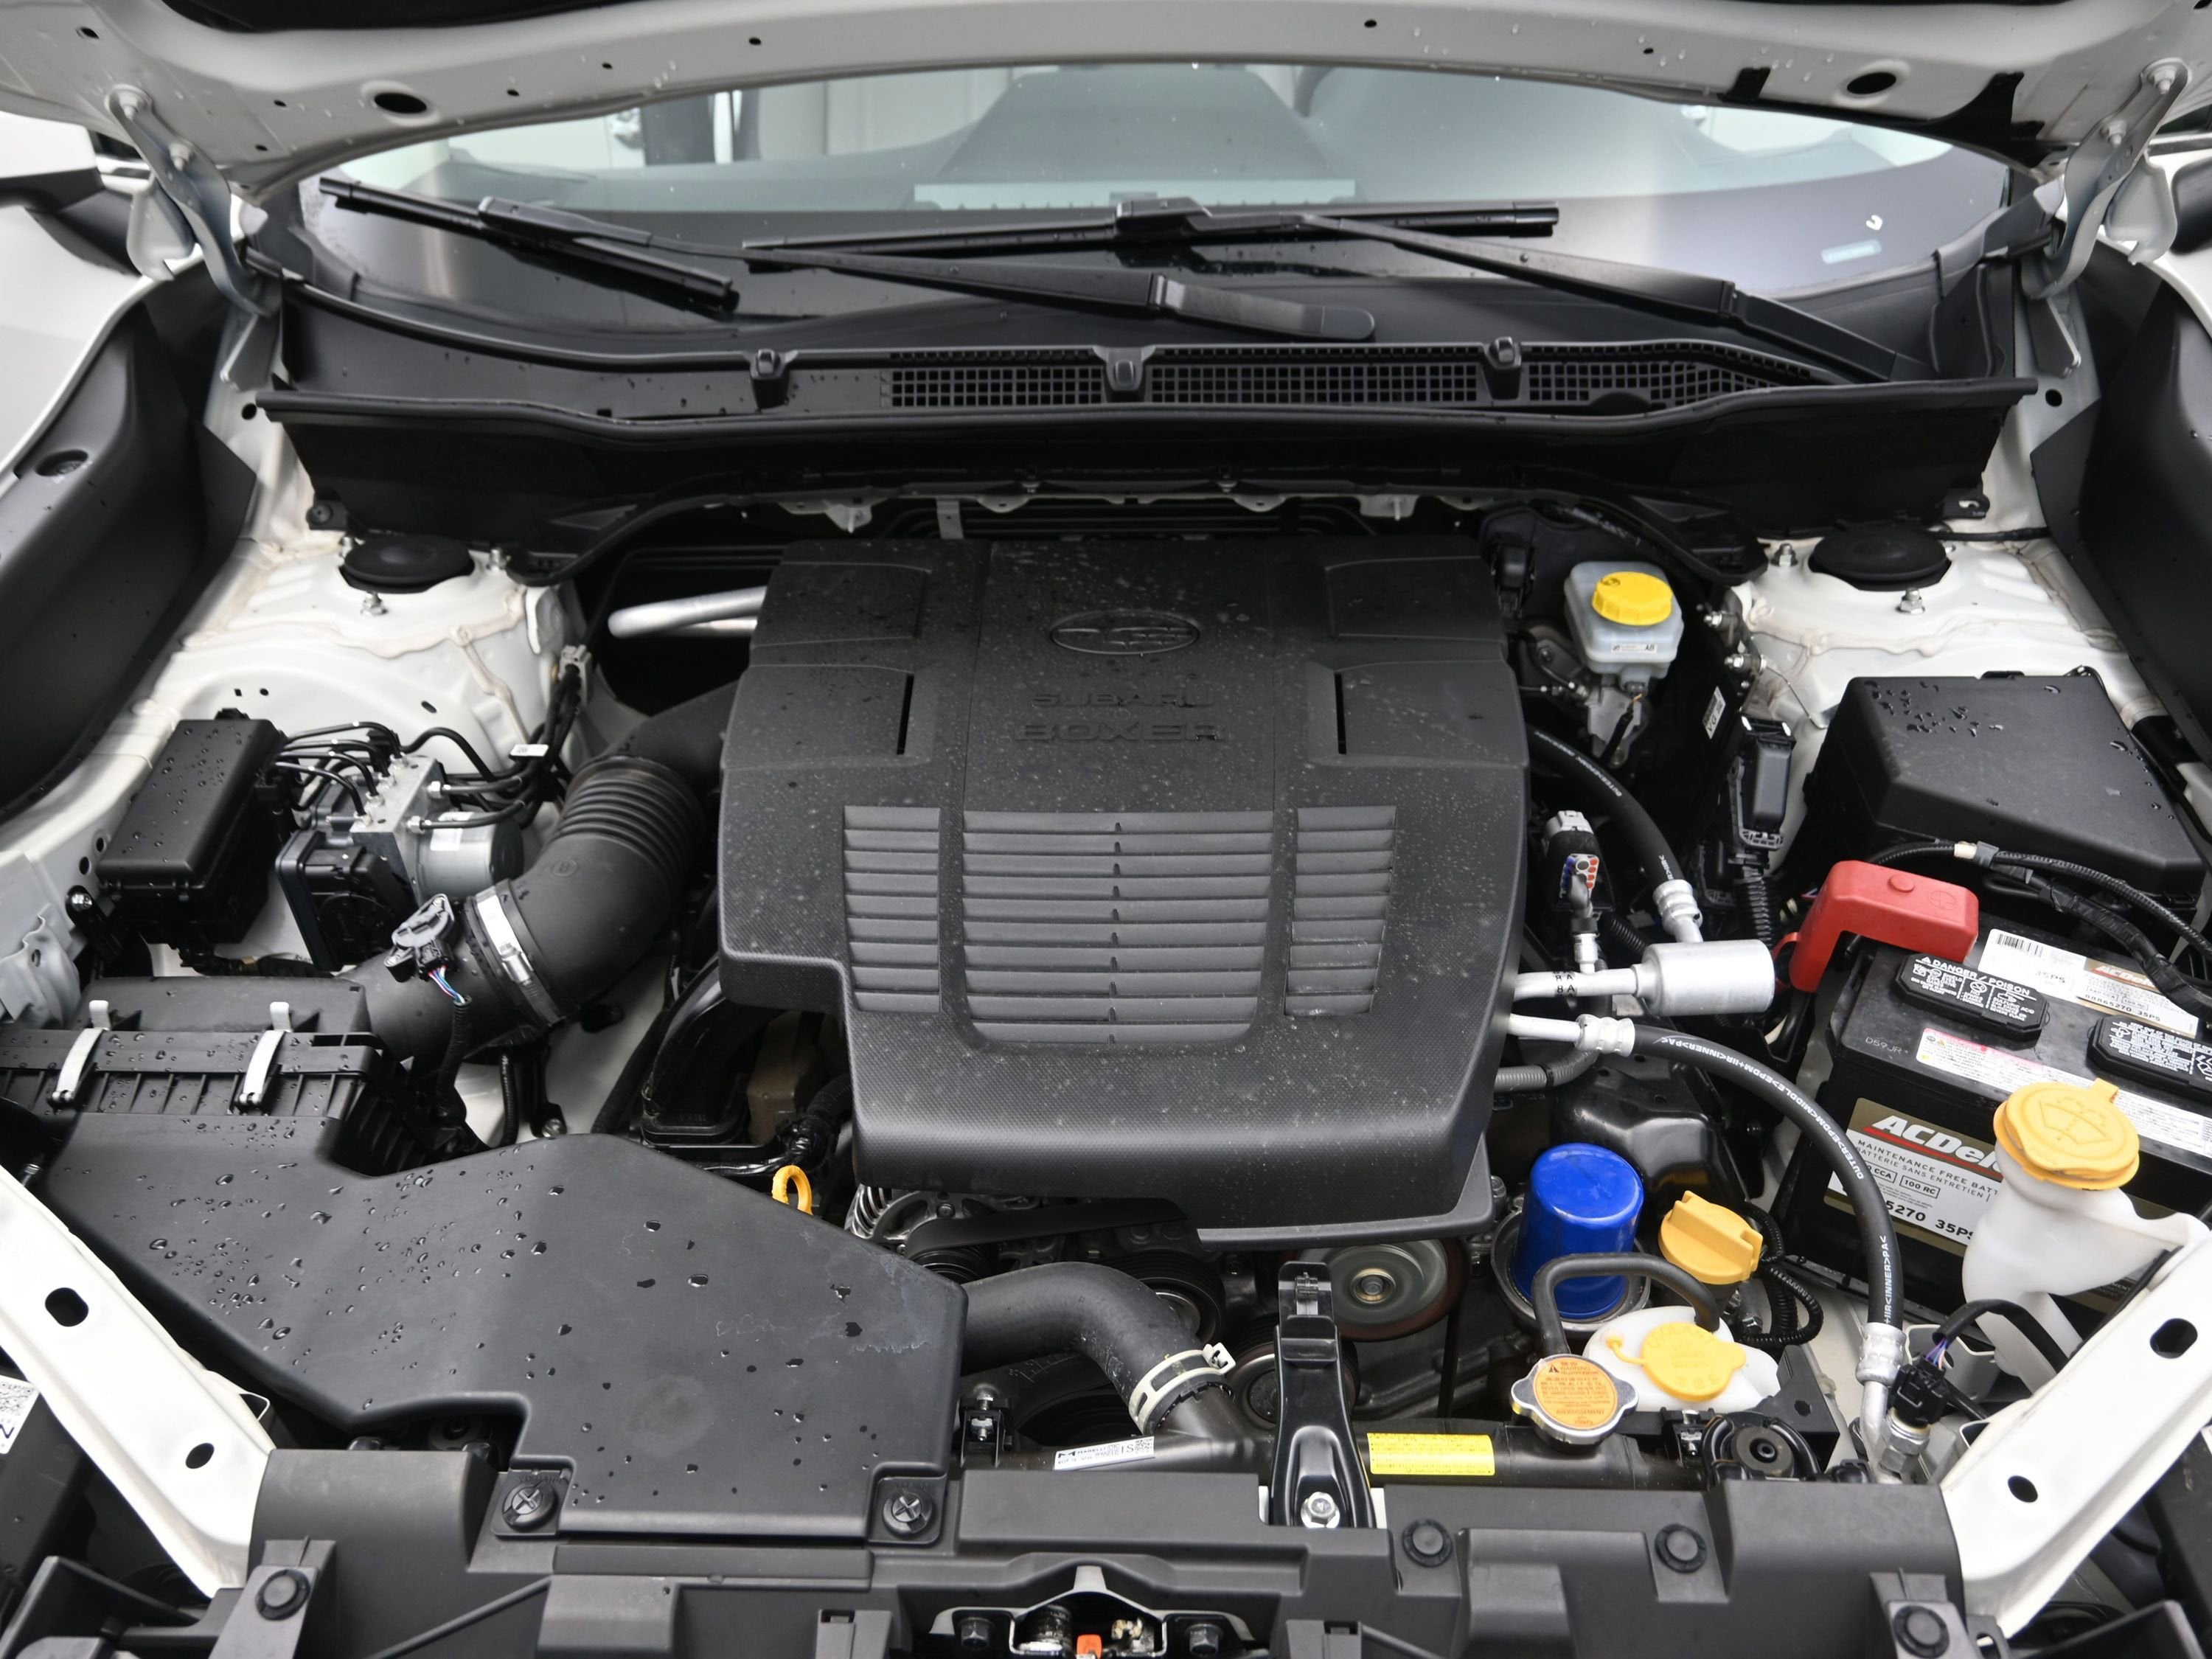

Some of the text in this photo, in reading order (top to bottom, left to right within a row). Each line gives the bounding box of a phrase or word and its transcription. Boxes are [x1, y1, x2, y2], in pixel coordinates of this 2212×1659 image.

[1015, 723, 1227, 741] BOXER
[1932, 959, 1978, 978] DANGER
[1989, 978, 2030, 995] POISON
[1857, 1147, 1899, 1167] BATTERIE
[1902, 1165, 1926, 1178] SANS
[1930, 1175, 1983, 1198] ENTRETIEN
[1858, 1140, 1935, 1172] MAINTENANCE
[1939, 1170, 1967, 1184] FREE
[1971, 1182, 1998, 1195] BATT
[1874, 1168, 1892, 1179] CCA
[1905, 1180, 1936, 1194] 100 RC
[1886, 1200, 1926, 1222] 5270
